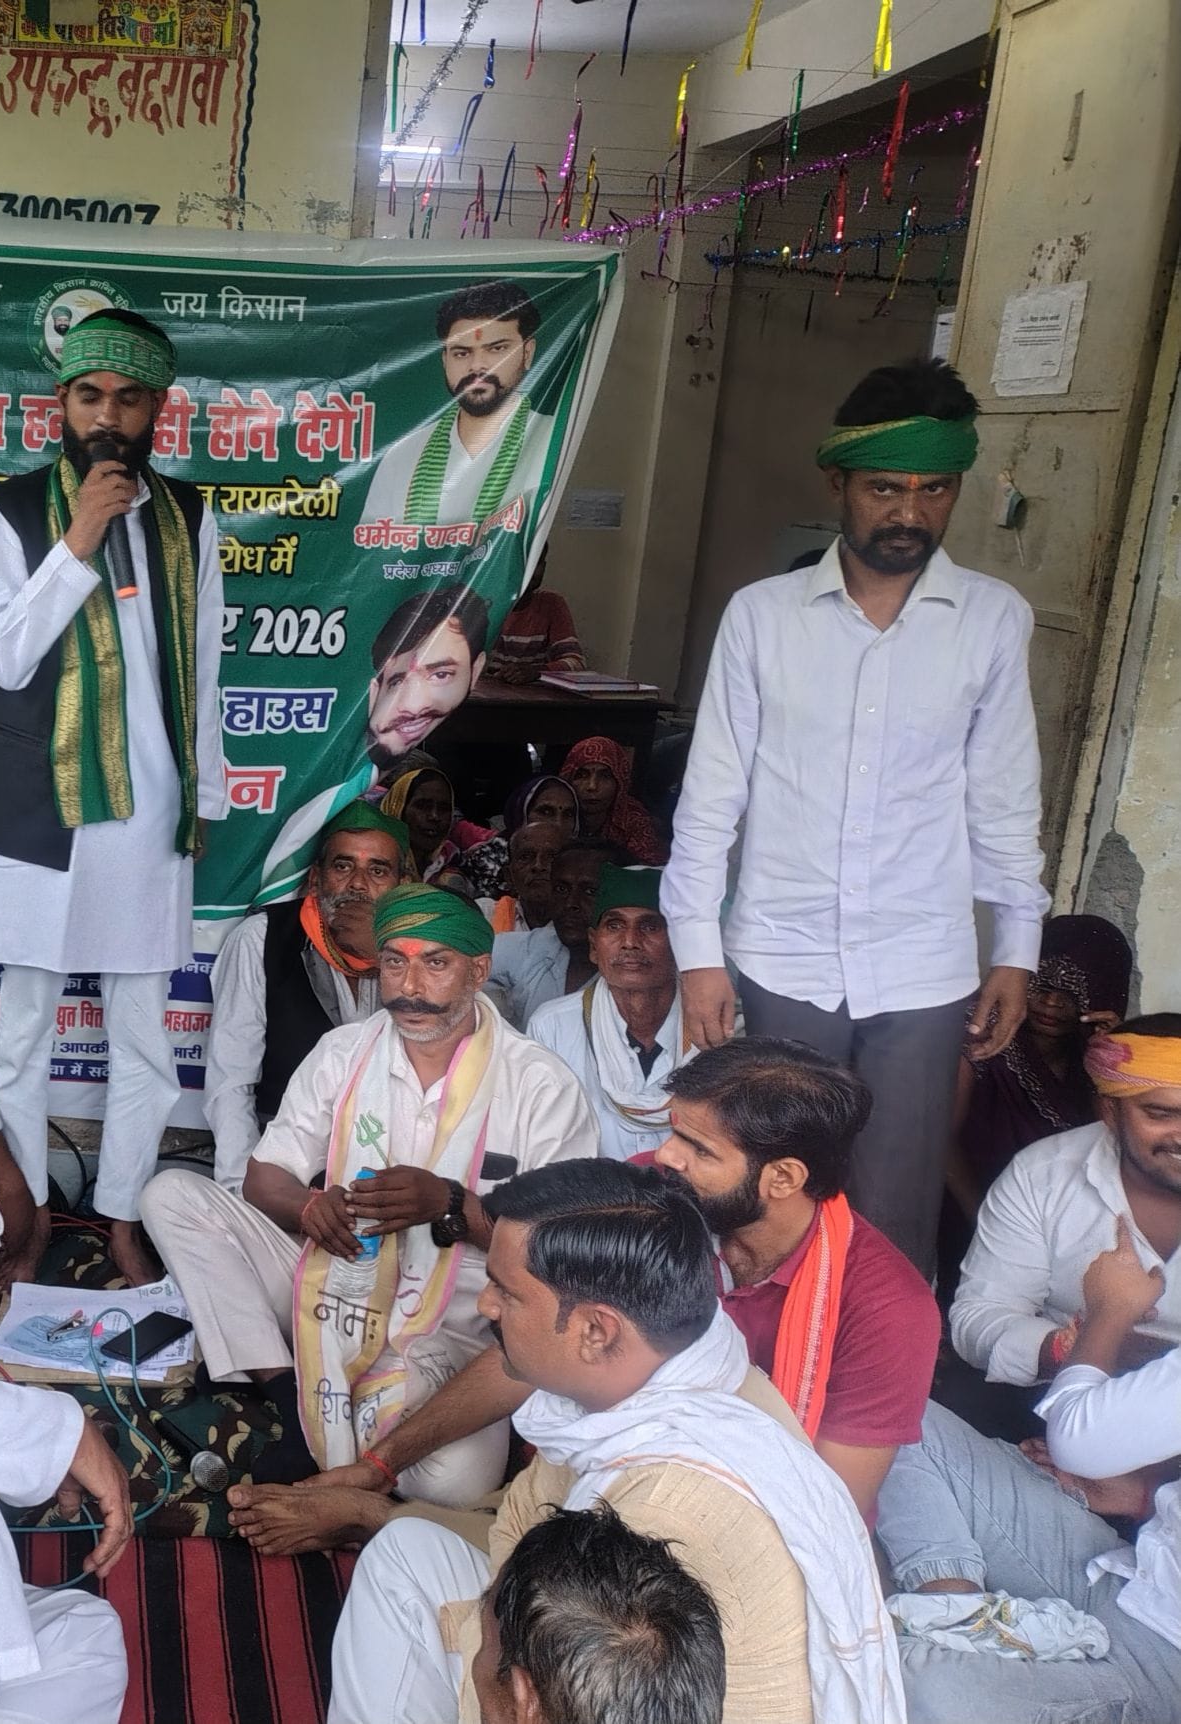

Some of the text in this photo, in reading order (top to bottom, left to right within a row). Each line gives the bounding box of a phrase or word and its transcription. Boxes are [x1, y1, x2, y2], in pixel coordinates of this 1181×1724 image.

[161, 285, 308, 322] जय किसान
[206, 387, 284, 462] होने
[220, 477, 342, 518] रायबरेली
[268, 535, 299, 575] में
[424, 522, 477, 549] यादव
[383, 559, 419, 580] प्रदेश
[421, 560, 459, 577] अध्यक्ष
[248, 606, 347, 656] 2026
[222, 687, 338, 735] हाउस
